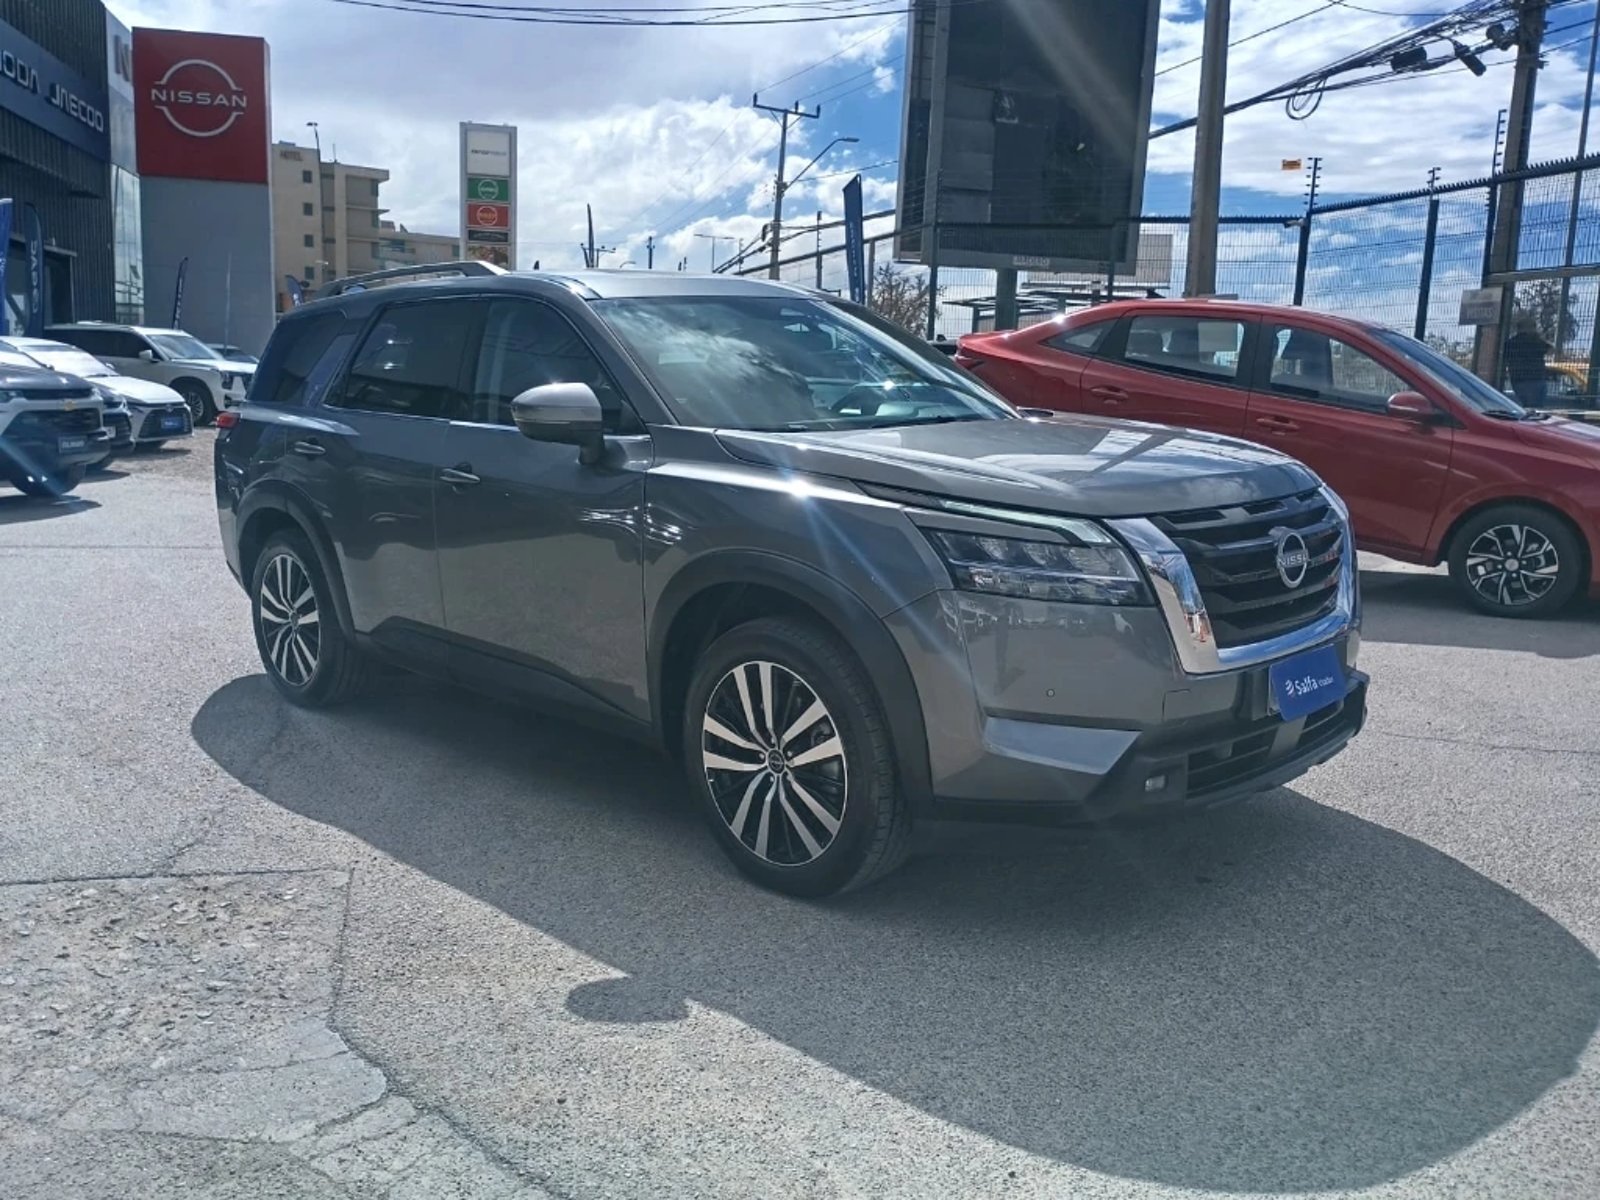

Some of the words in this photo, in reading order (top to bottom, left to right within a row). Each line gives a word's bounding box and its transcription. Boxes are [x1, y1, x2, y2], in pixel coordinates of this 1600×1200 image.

[0, 49, 40, 94] ODA
[51, 83, 104, 133] JAECOO
[151, 88, 247, 108] NISSAN
[1278, 553, 1309, 566] NISS
[1295, 675, 1318, 695] Salfa
